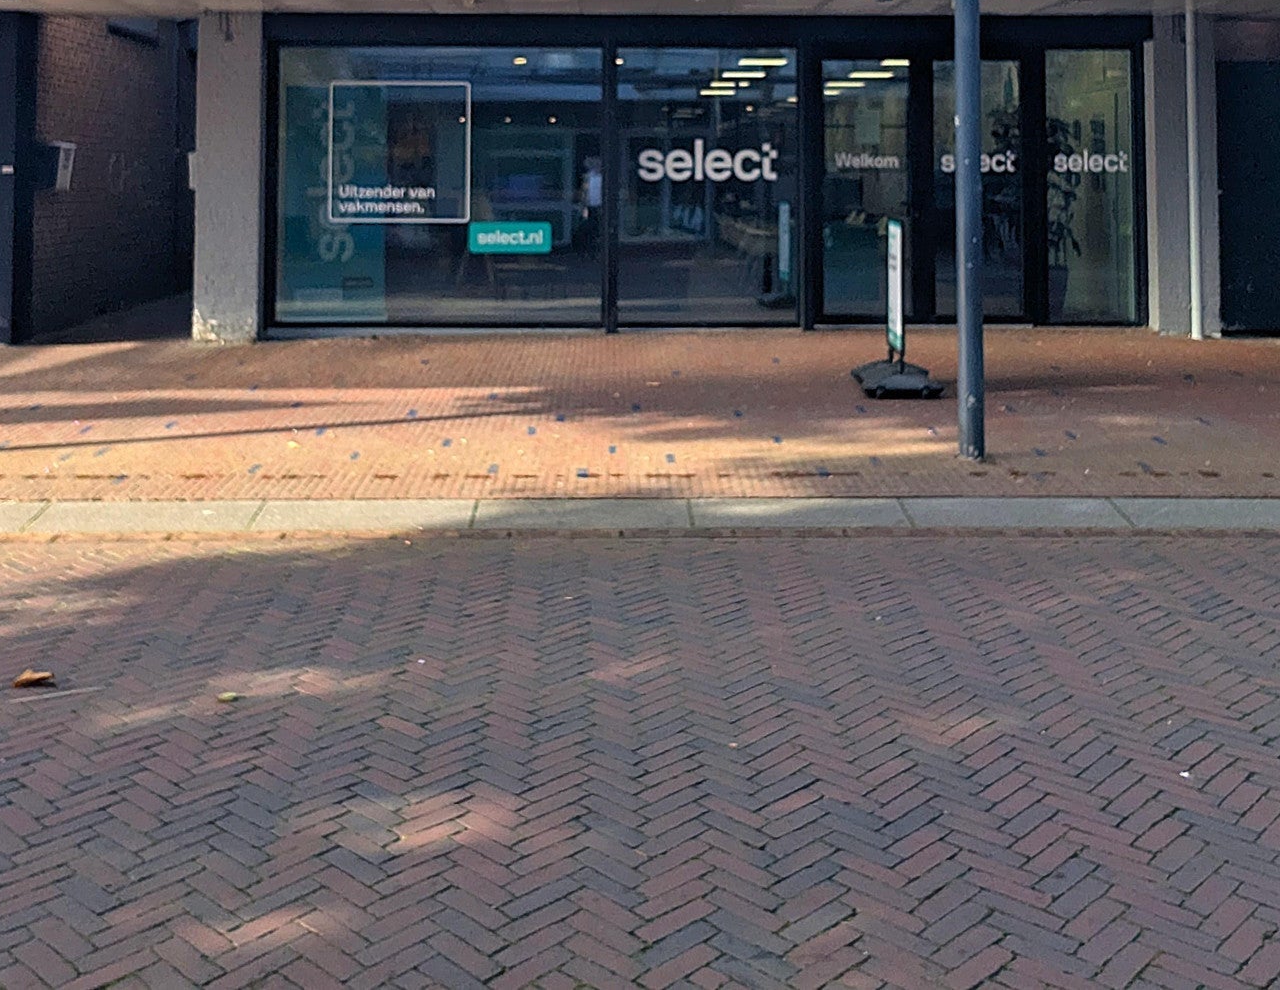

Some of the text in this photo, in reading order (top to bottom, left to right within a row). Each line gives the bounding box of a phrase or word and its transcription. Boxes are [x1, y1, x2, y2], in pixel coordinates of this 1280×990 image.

[638, 138, 779, 182] select
[834, 152, 900, 169] Welkom
[940, 149, 1016, 174] sect
[1053, 148, 1129, 173] select
[338, 184, 436, 199] Uitzender van
[338, 200, 425, 214] vakmensen.
[477, 229, 543, 245] select.nl
